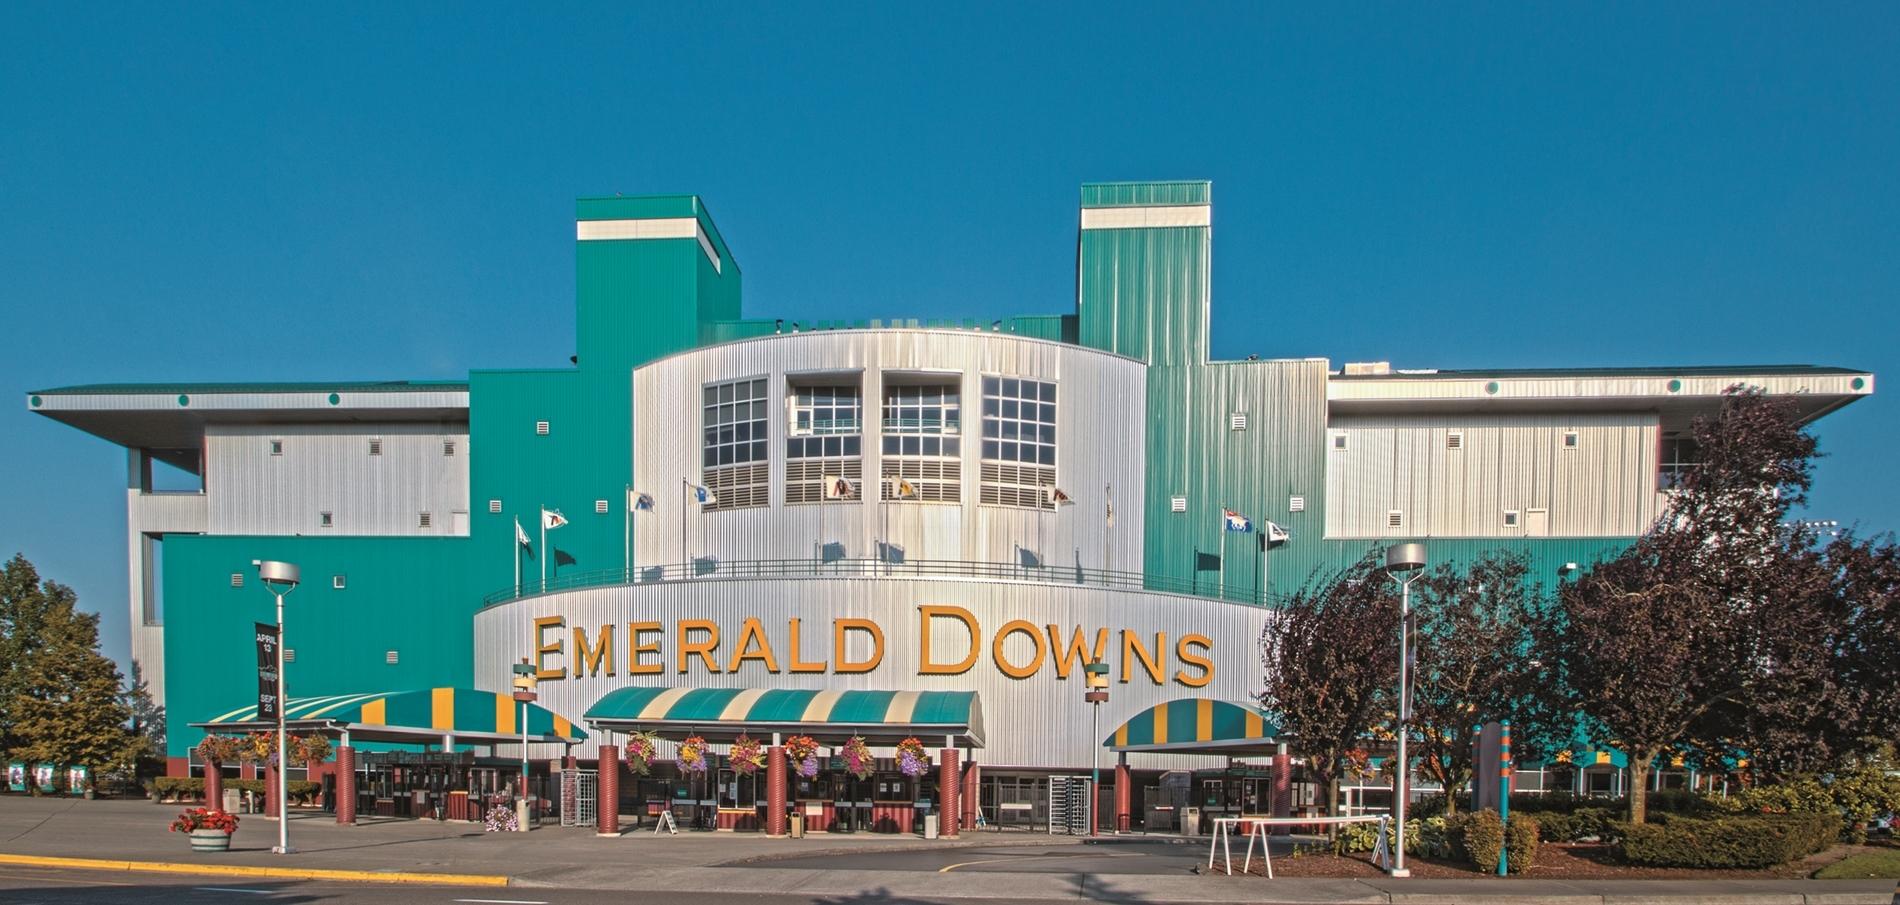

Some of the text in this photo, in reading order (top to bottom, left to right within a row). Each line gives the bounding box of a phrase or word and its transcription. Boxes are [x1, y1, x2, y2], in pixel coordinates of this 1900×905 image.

[256, 633, 277, 645] APRIL
[263, 644, 272, 653] 13
[533, 604, 1216, 688] EMERALD DOWNS
[260, 694, 277, 704] SEPT
[264, 704, 273, 712] 23
